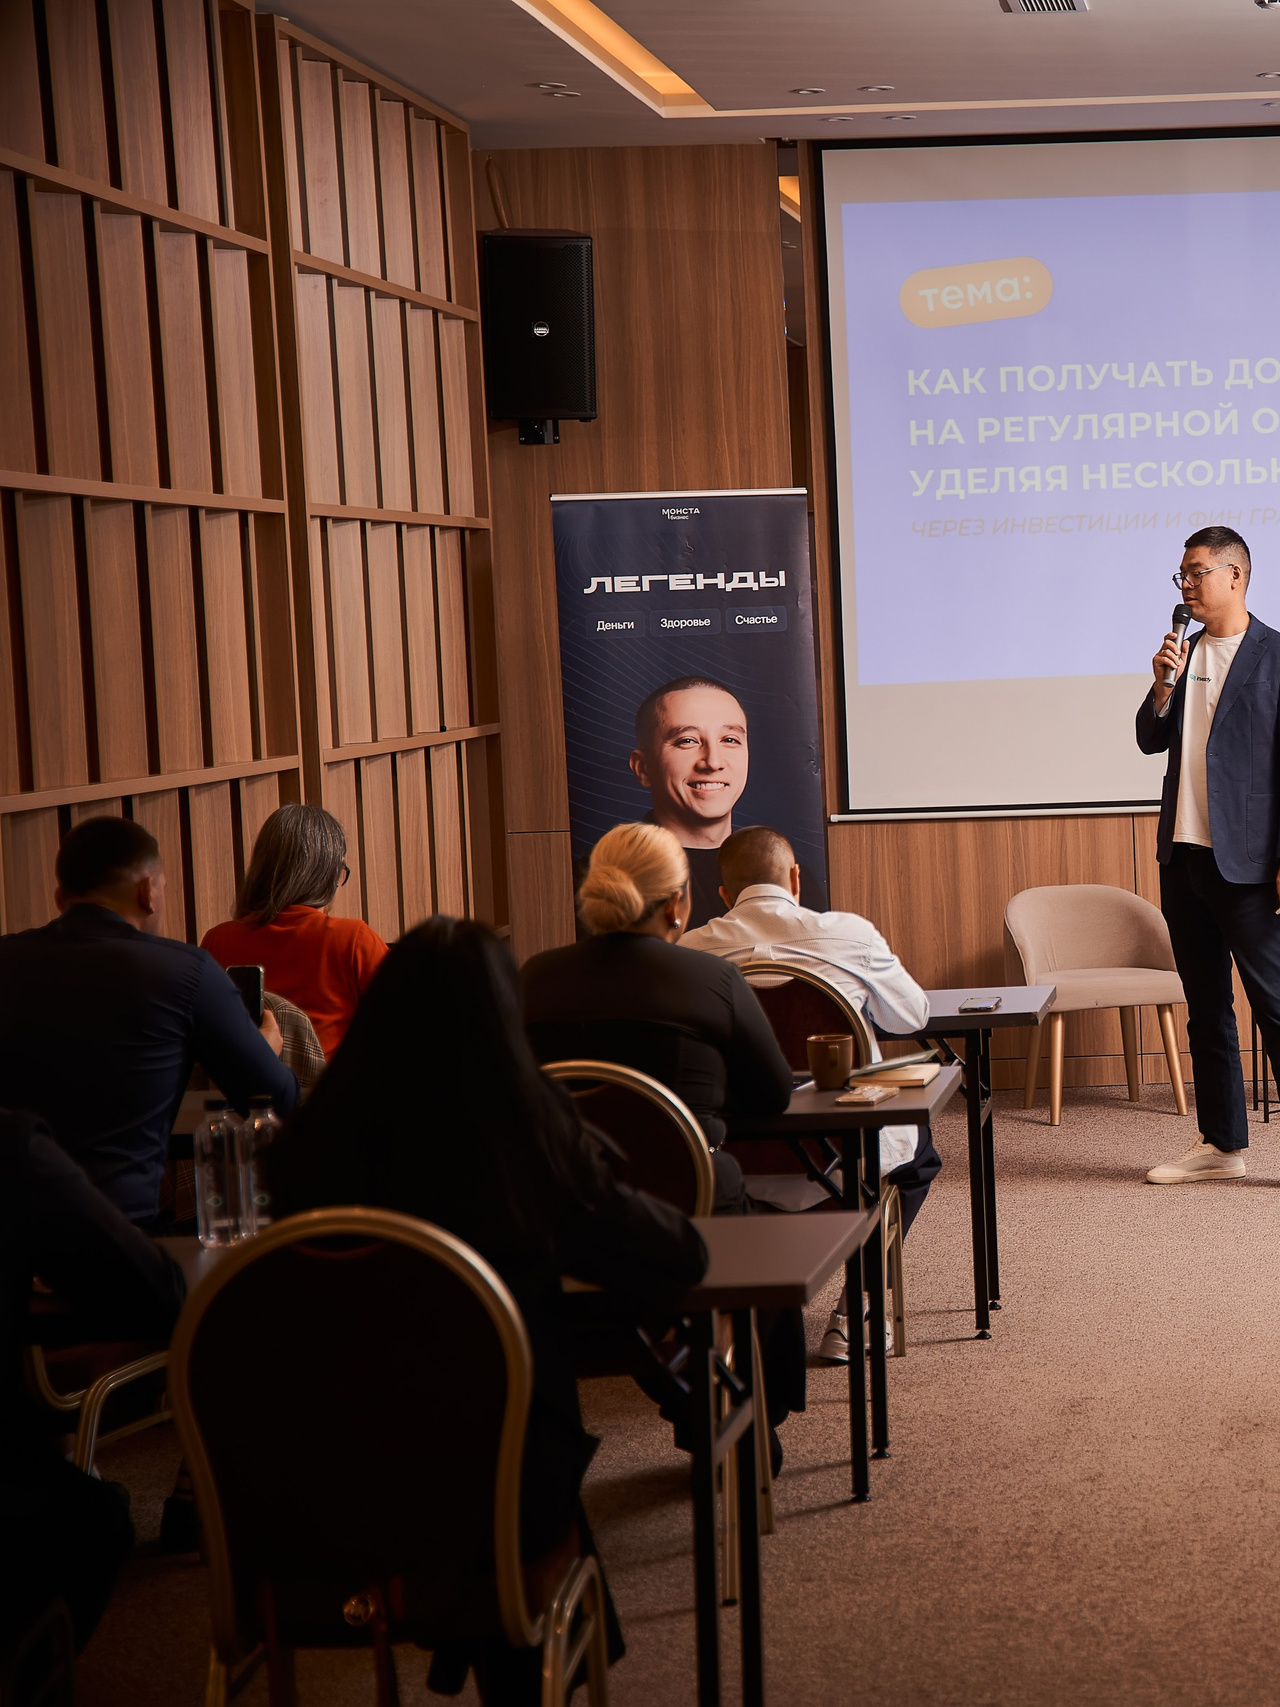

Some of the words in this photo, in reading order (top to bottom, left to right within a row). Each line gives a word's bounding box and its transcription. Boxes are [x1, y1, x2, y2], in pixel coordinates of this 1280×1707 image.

[919, 275, 1033, 312] тема:
[908, 367, 987, 396] КАК
[1000, 360, 1214, 393] ПОЛУЧАТЬ
[910, 419, 965, 446] НА
[977, 402, 1239, 444] РЕГУЛЯРНОЙ
[910, 465, 1068, 500] УДЕЛЯЯ
[911, 518, 985, 538] ЧЕРЕЗ
[993, 512, 1158, 535] ИНВЕСТИЦИИ
[1164, 512, 1182, 529] И
[1187, 510, 1243, 527] ФИН
[584, 570, 786, 594] ЛЕГЕНДЫ
[597, 620, 635, 632] Деньги
[660, 617, 711, 629] Здоровье
[735, 614, 778, 625] Счастье
